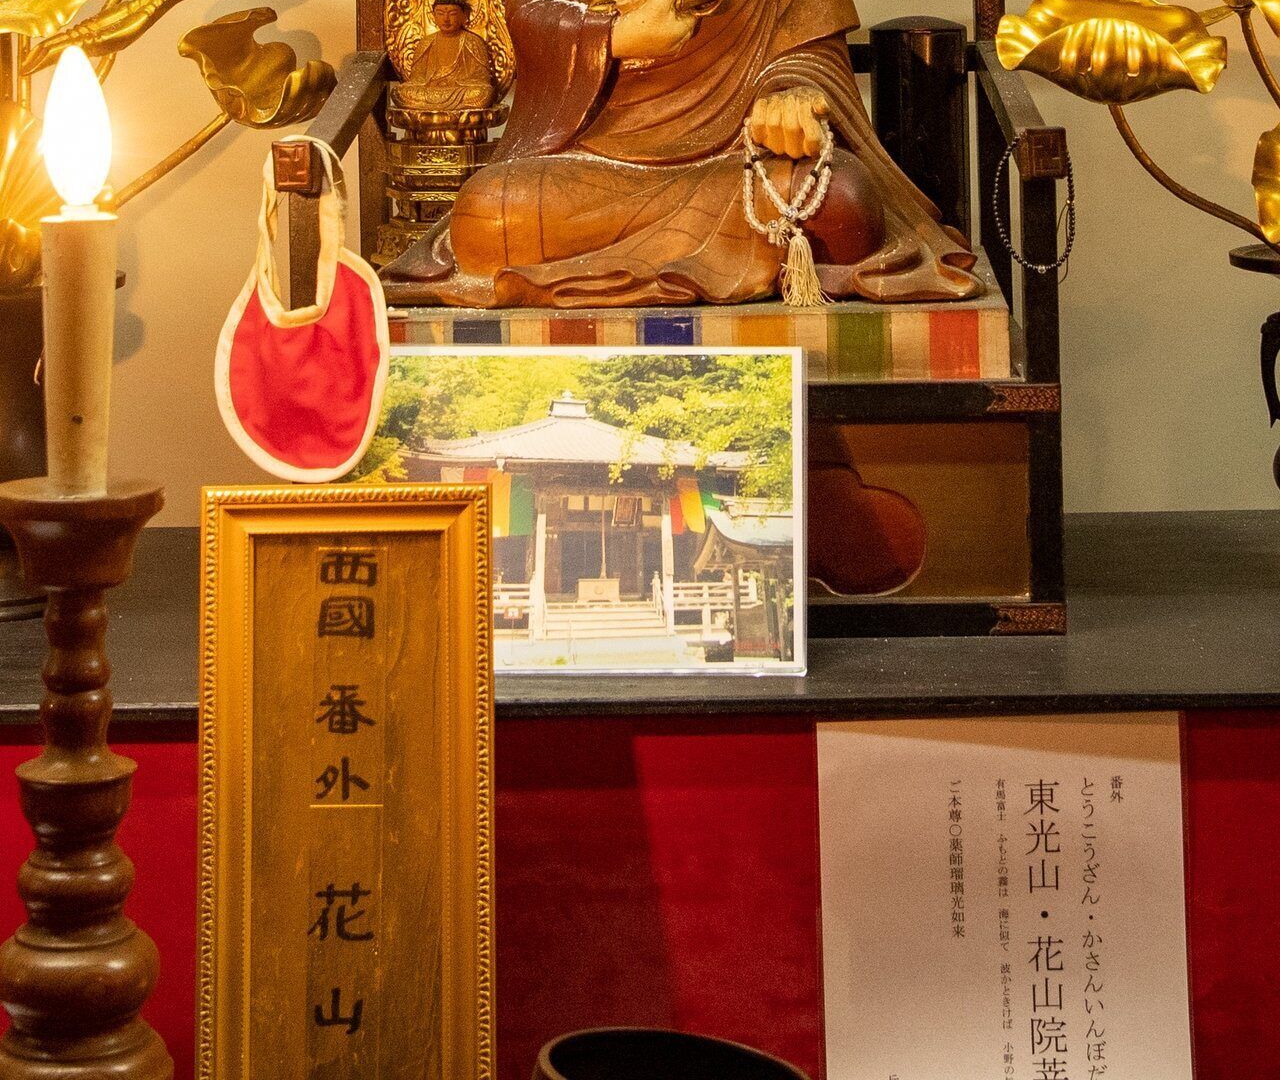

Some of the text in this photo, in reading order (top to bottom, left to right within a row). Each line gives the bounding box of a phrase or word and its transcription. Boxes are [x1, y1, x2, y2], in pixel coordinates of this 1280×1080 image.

[1110, 775, 1124, 804] 番外
[1003, 1042, 1015, 1080] 小野の
